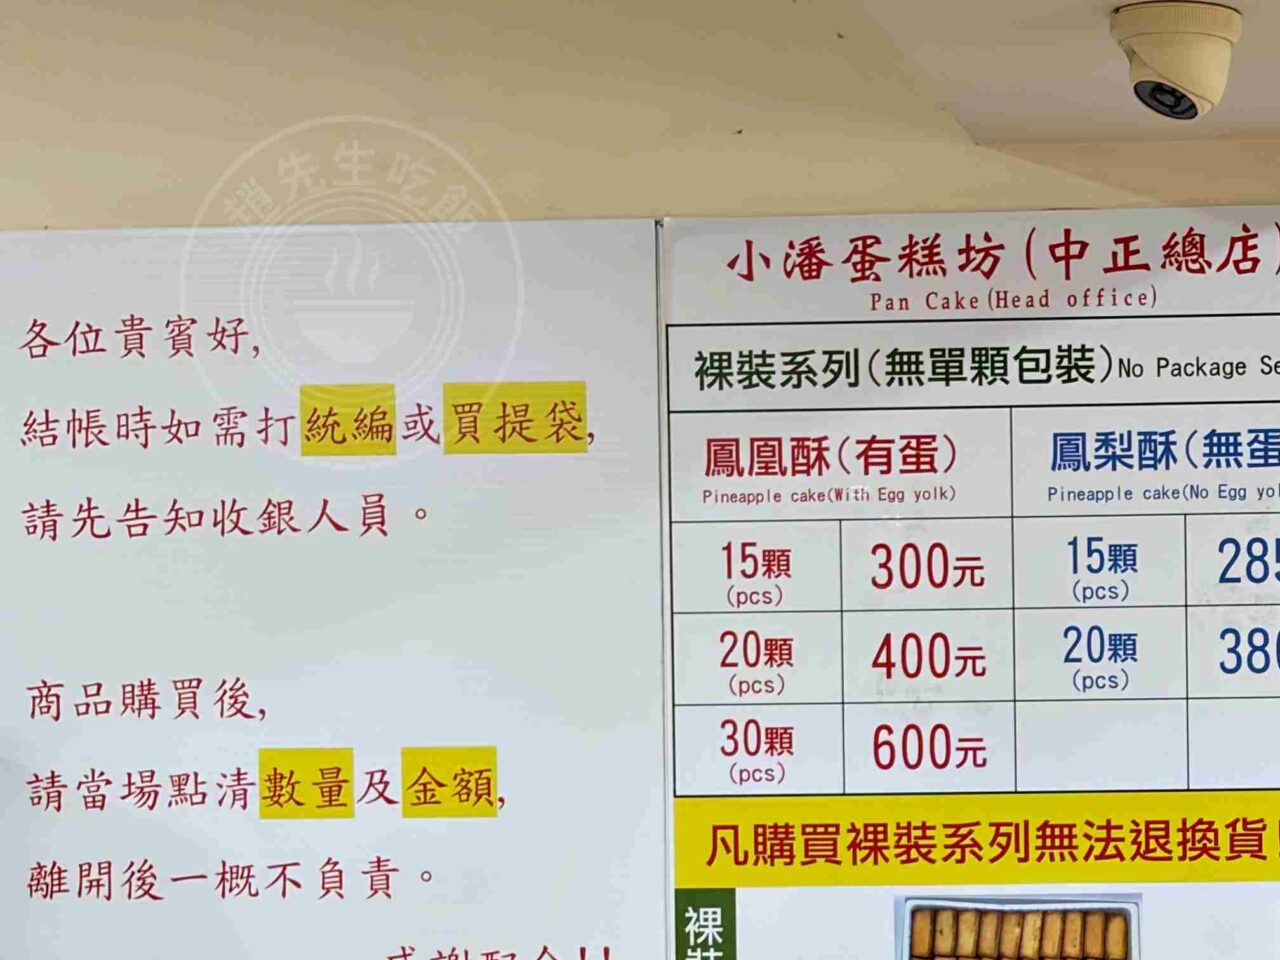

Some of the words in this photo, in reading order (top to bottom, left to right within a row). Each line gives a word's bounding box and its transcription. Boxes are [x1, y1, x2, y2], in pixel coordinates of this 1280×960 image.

[869, 292, 910, 312] Pan
[1066, 286, 1159, 310] office)
[19, 312, 261, 360] 各位貴賓好,
[1155, 355, 1247, 382] Package
[20, 398, 595, 449] 結帳時如需打統編或買提袋,
[703, 432, 959, 480] 鳳凰酥(有蛋)
[702, 488, 786, 505] Pineapple
[788, 486, 872, 504] cake(With
[876, 487, 908, 505] Egg
[911, 486, 957, 504] yolk)
[1047, 485, 1134, 504] Pineapple
[1141, 484, 1211, 503] cake(No
[1216, 484, 1248, 503] Egg
[20, 493, 428, 541] 請先告知收銀人員。
[719, 539, 794, 582] 15顆
[868, 541, 987, 591] 300元
[1065, 534, 1140, 577] 15顆
[1070, 580, 1131, 603] (pcs)
[717, 629, 796, 672] 20顆
[870, 631, 989, 681] 400元
[1061, 624, 1139, 666] 20顆
[26, 676, 267, 721] 商品購買後,
[718, 717, 796, 760] 30顆
[871, 722, 990, 771] 600元
[26, 765, 505, 812] 請當場點清數量及金額,
[26, 856, 433, 903] 離開後一概不負責。
